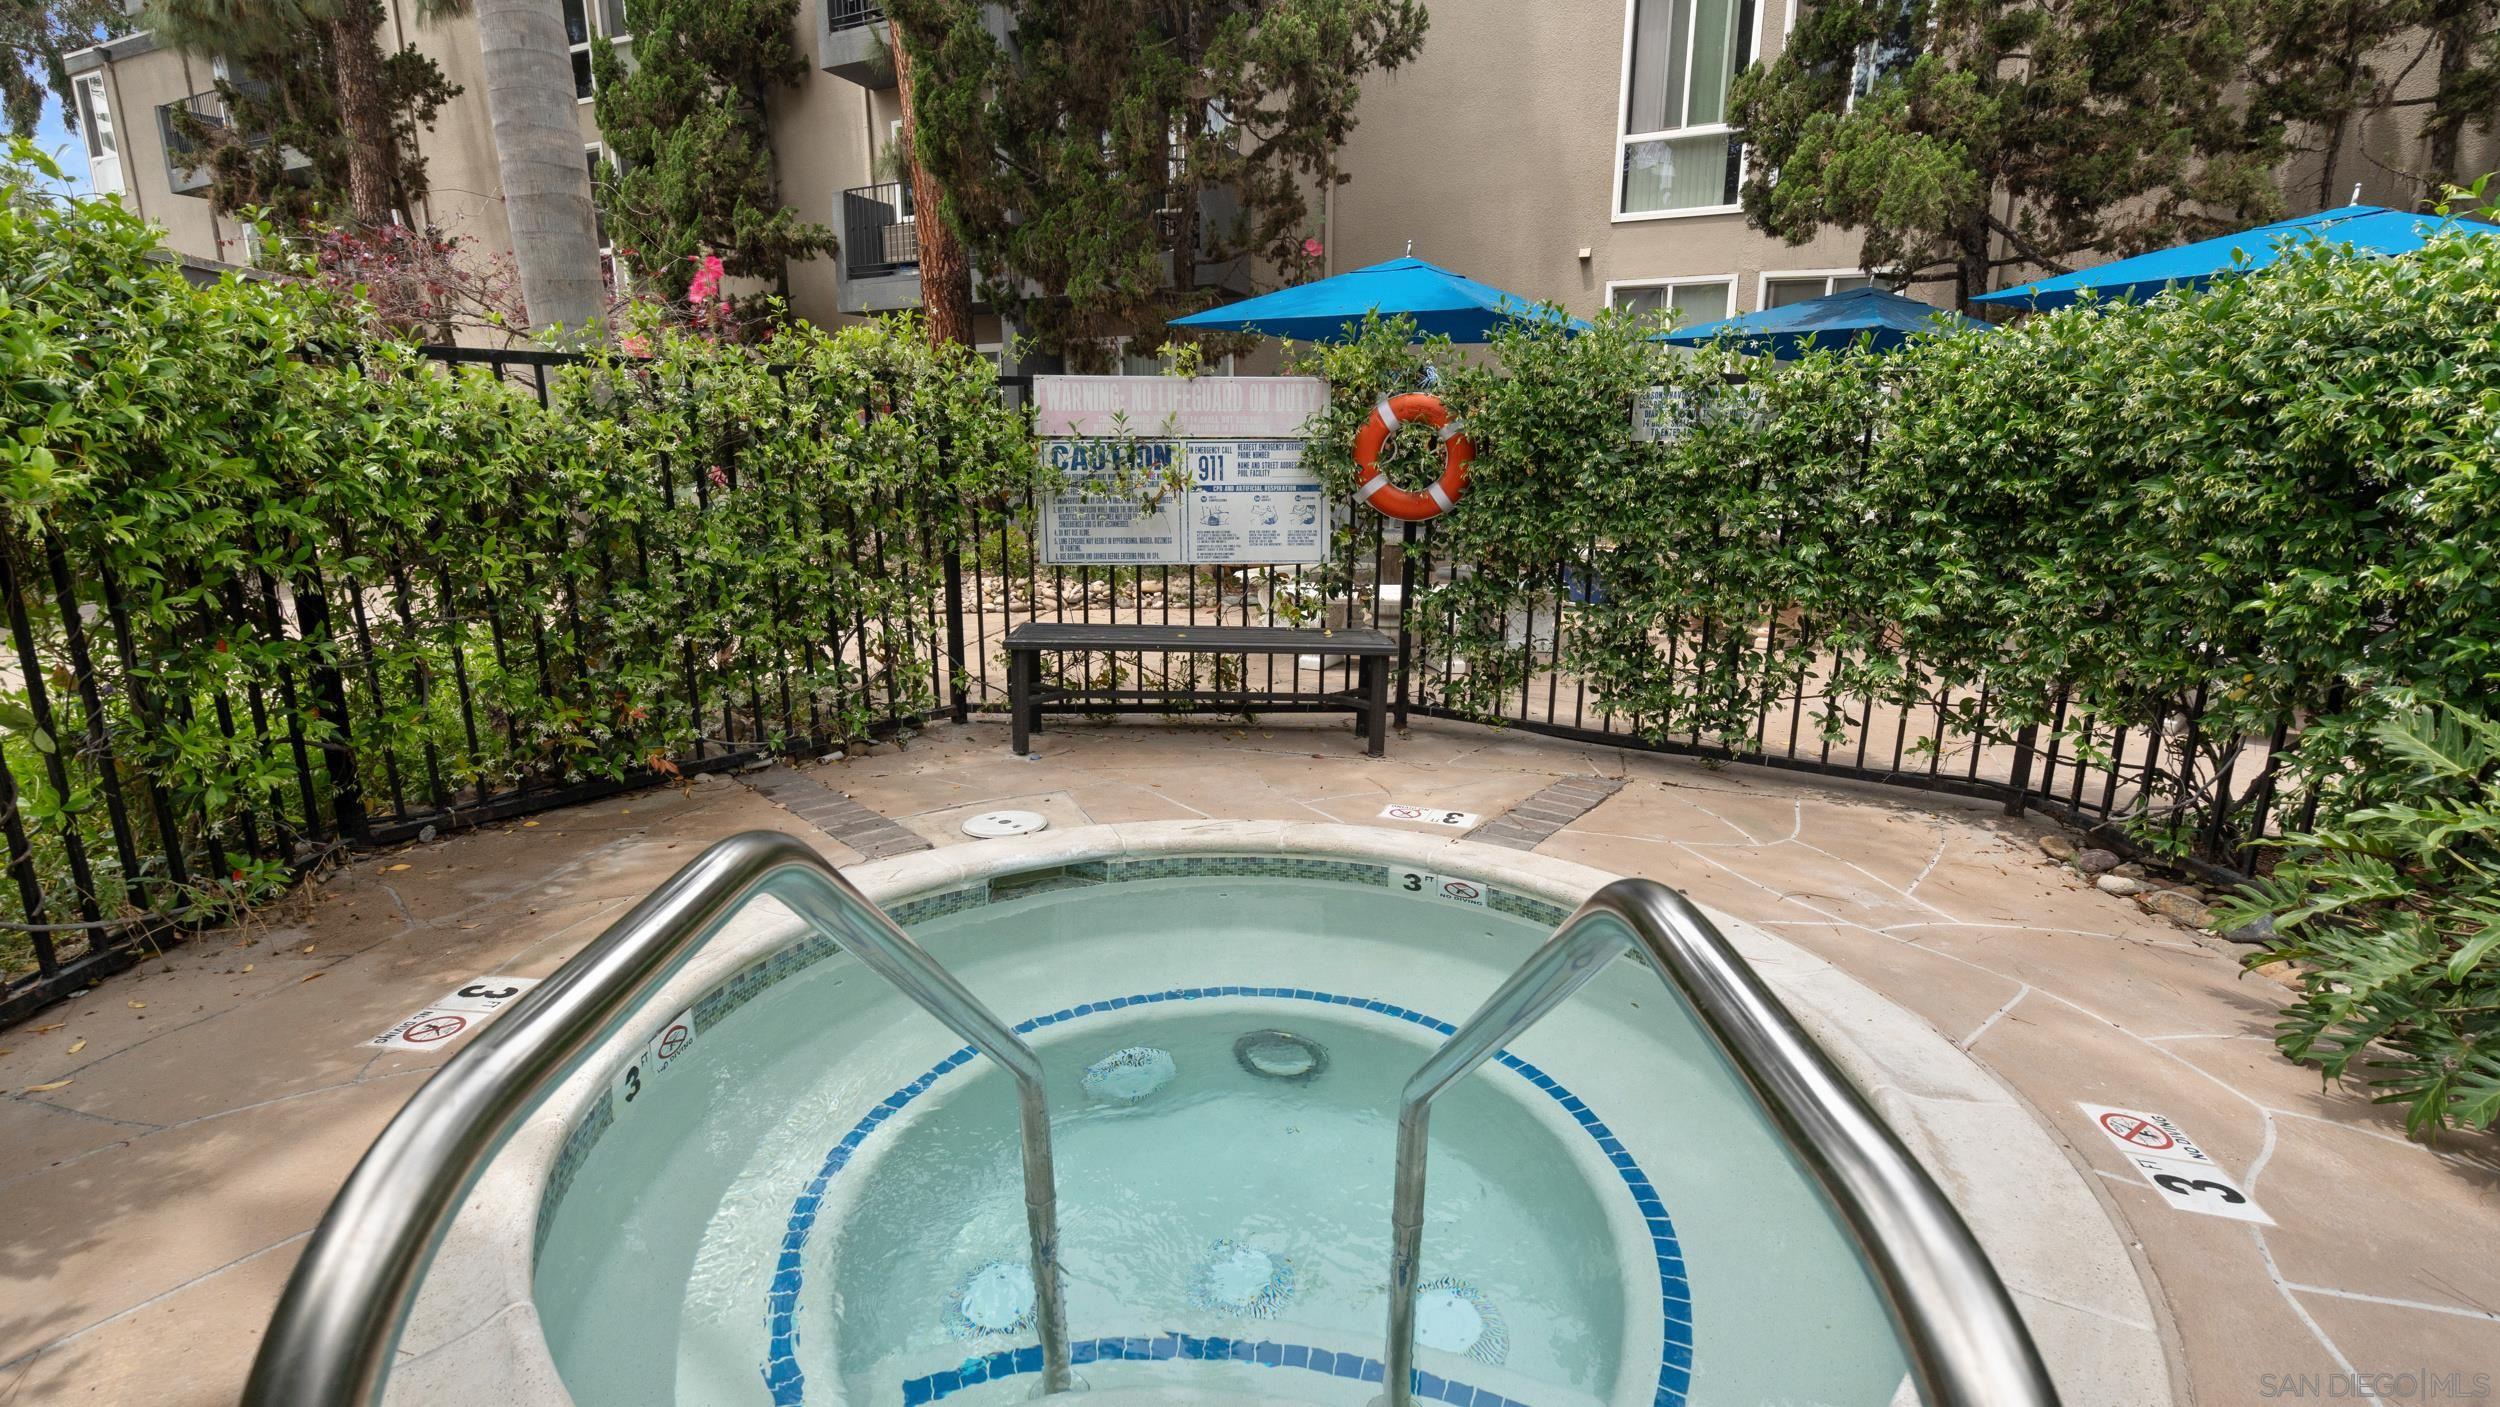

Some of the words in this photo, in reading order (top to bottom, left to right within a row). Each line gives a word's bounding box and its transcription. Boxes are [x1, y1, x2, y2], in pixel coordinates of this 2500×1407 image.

[1046, 383, 1125, 412] WARNING:
[1131, 383, 1152, 412] NO
[1158, 383, 1242, 412] LIFEGUARD
[1249, 383, 1269, 412] ON
[1275, 383, 1318, 412] DUTY
[1188, 446, 1194, 454] IN
[1195, 446, 1220, 454] EMERGENCY
[1221, 446, 1232, 454] CALL
[1237, 443, 1257, 451] NEAREST
[1258, 443, 1284, 451] EMERGENCY
[1237, 451, 1252, 459] PHONE
[1252, 451, 1270, 459] NUMBER
[1198, 455, 1224, 481] 911
[1237, 461, 1251, 469] NAME
[1251, 461, 1260, 469] AND
[1261, 461, 1279, 469] STREET
[1280, 461, 1297, 469] ADDRES
[1237, 469, 1249, 477] POOL
[1249, 469, 1270, 477] FACILITY
[1442, 812, 1465, 824] 3
[1403, 873, 1422, 892] 3
[1424, 875, 1435, 883] FT
[1454, 896, 1483, 906] DIVING
[457, 984, 519, 999] 3
[374, 1021, 418, 1044] DIVING
[669, 1038, 694, 1062] DIVING
[625, 1065, 641, 1103] 3
[640, 1051, 648, 1067] FT
[2151, 1115, 2189, 1145] DIVING
[2183, 1146, 2208, 1161] NO
[2135, 1158, 2163, 1171] FT
[2153, 1174, 2246, 1204] 3
